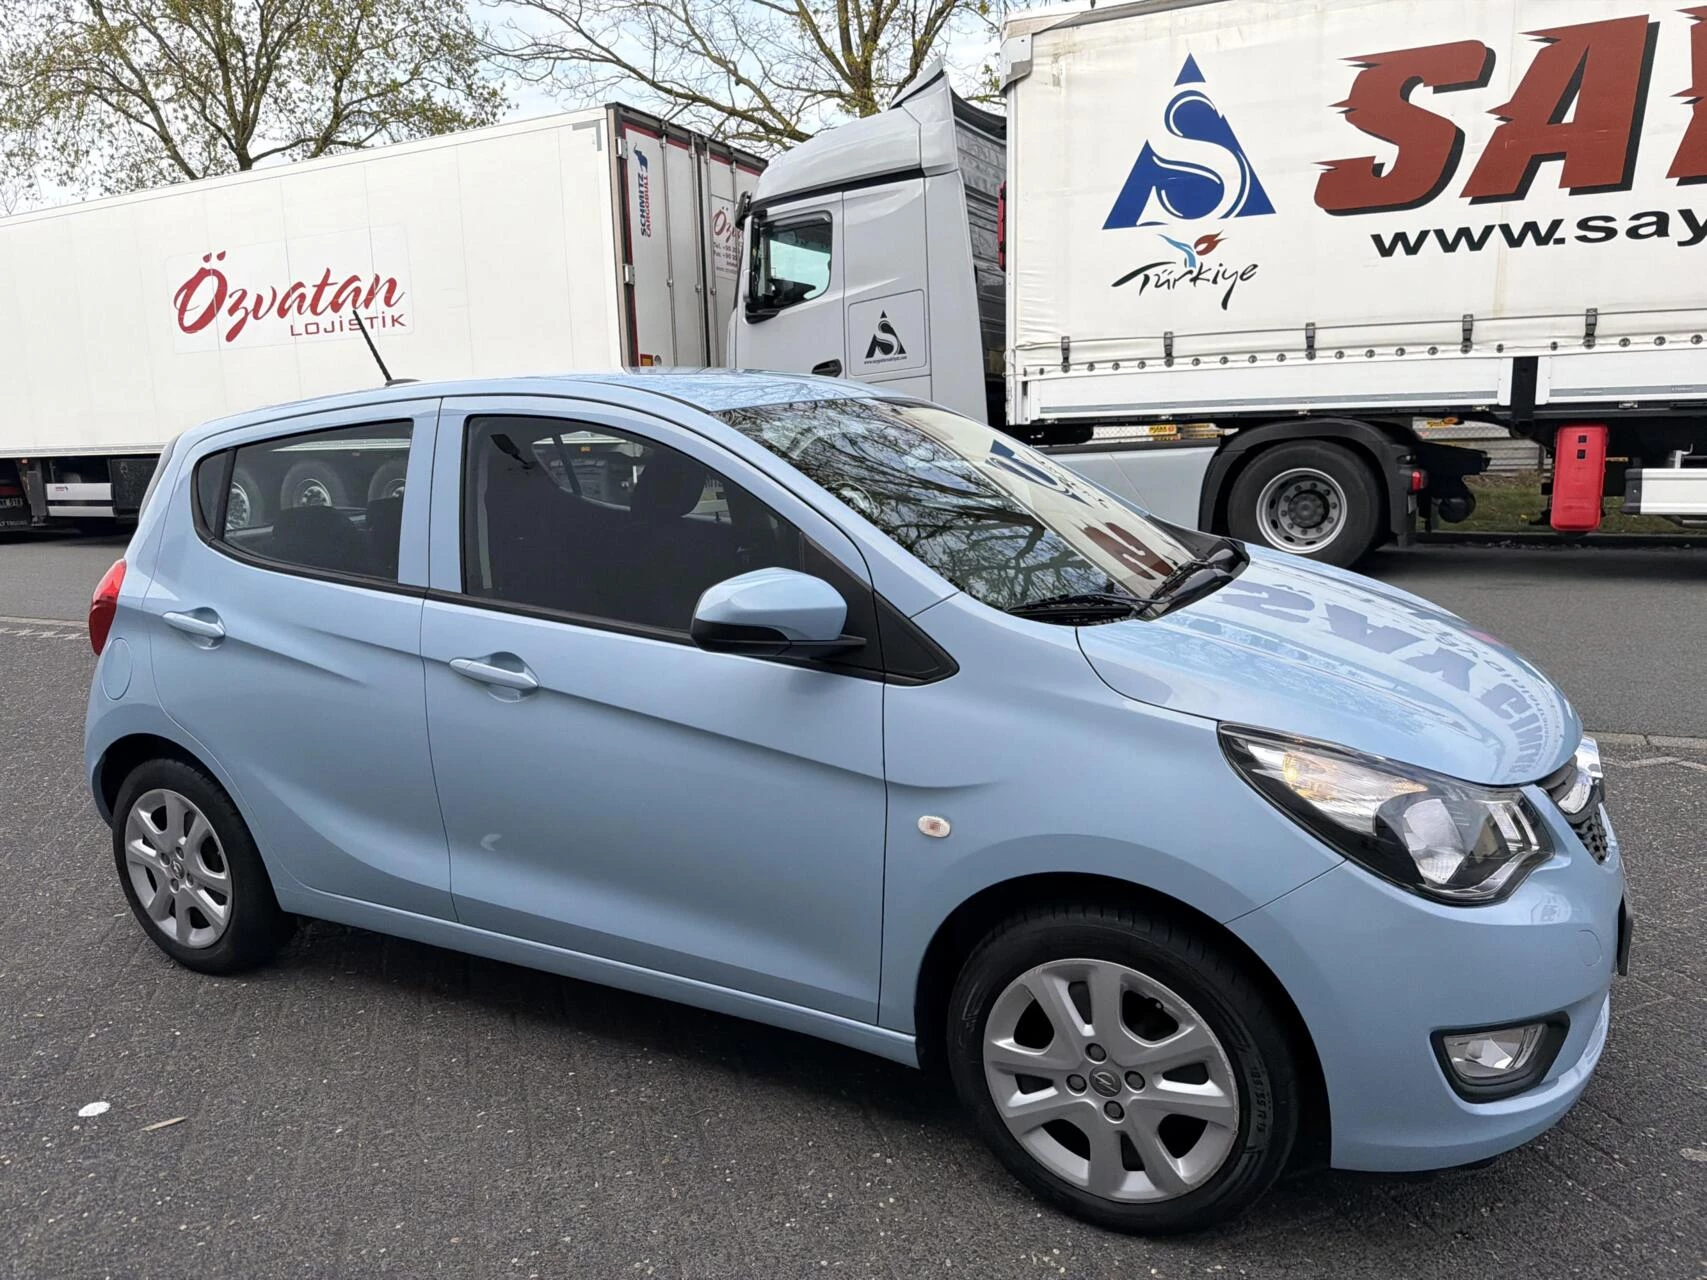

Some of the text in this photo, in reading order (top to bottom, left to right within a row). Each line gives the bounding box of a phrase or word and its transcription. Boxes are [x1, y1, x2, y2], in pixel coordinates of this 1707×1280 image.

[1310, 5, 1707, 217] SA
[638, 172, 647, 237] SCHMITZ
[643, 174, 652, 238] CARGOBULL
[173, 250, 405, 342] Özvatan
[1111, 254, 1259, 310] Türkiye
